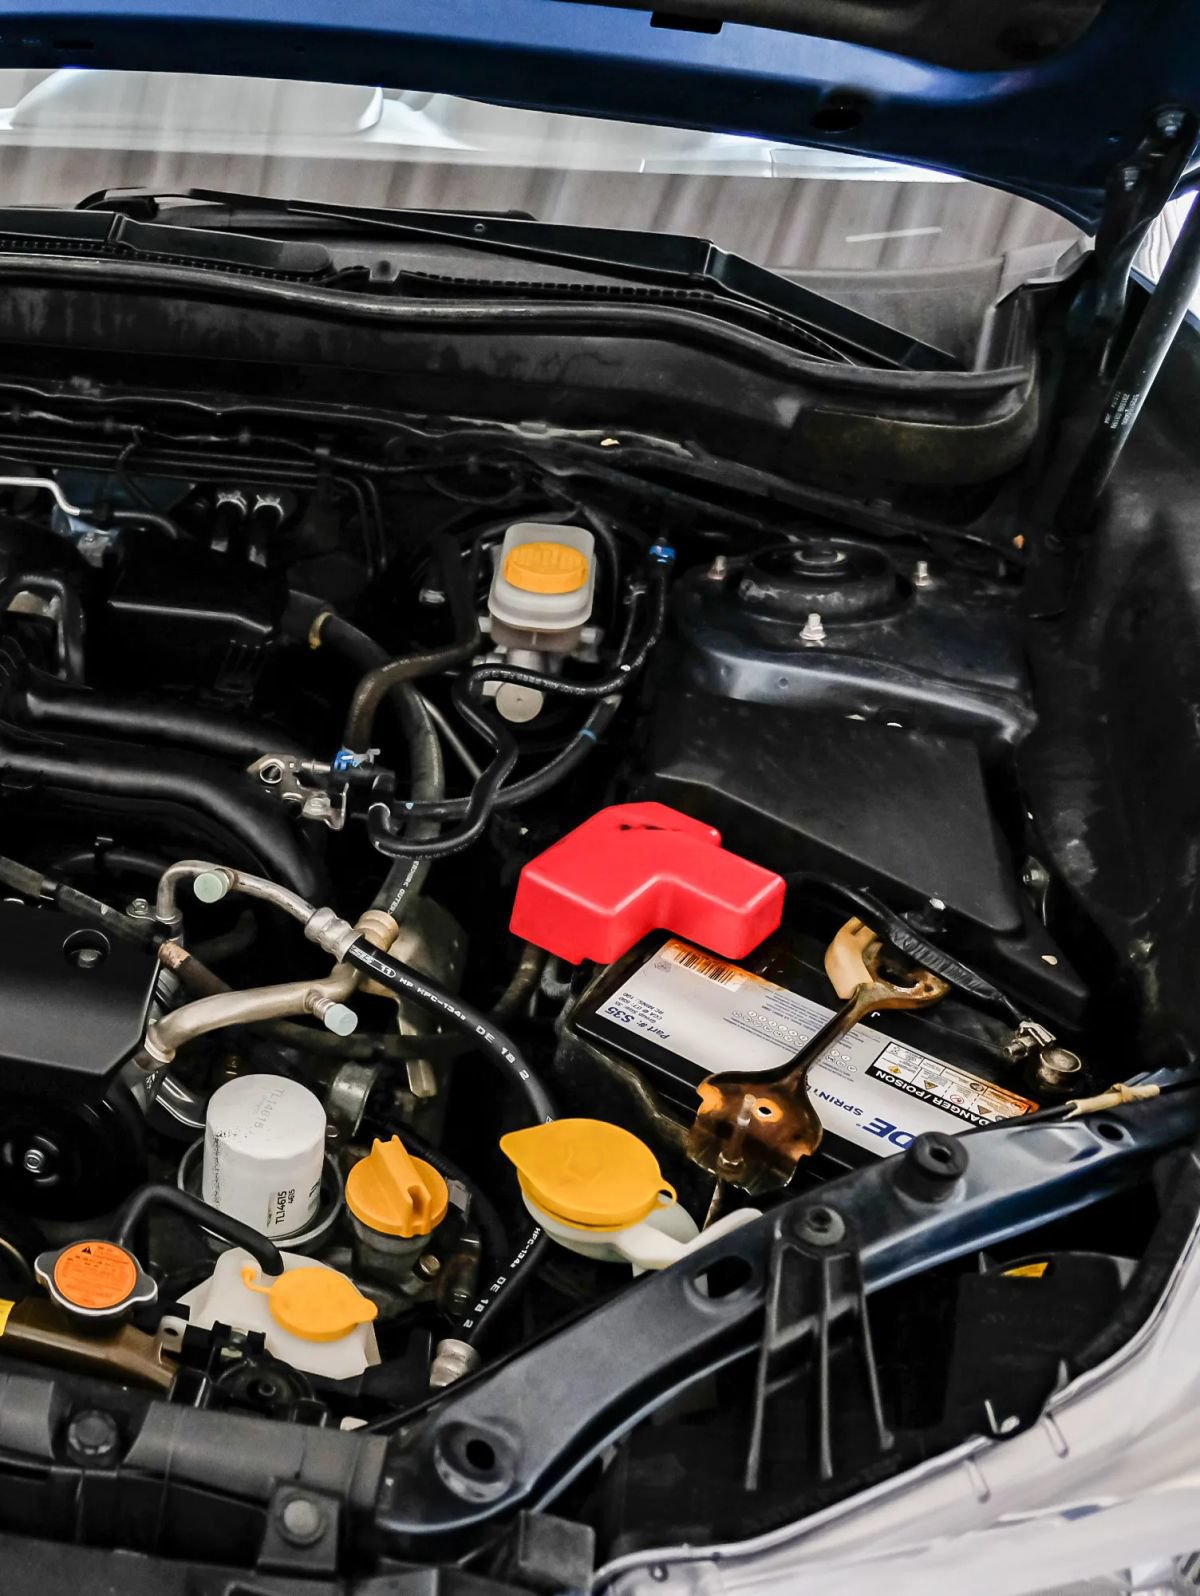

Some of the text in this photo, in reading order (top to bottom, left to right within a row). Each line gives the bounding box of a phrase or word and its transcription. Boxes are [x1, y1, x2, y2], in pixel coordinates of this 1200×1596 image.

[605, 1006, 635, 1023] S35
[476, 1025, 496, 1044] DE
[647, 1026, 670, 1039] Part
[932, 1095, 990, 1126] DANGER
[862, 1117, 917, 1150] DE
[288, 1189, 296, 1204] 4615
[275, 1191, 287, 1224] TL14615
[490, 1276, 507, 1293] DE
